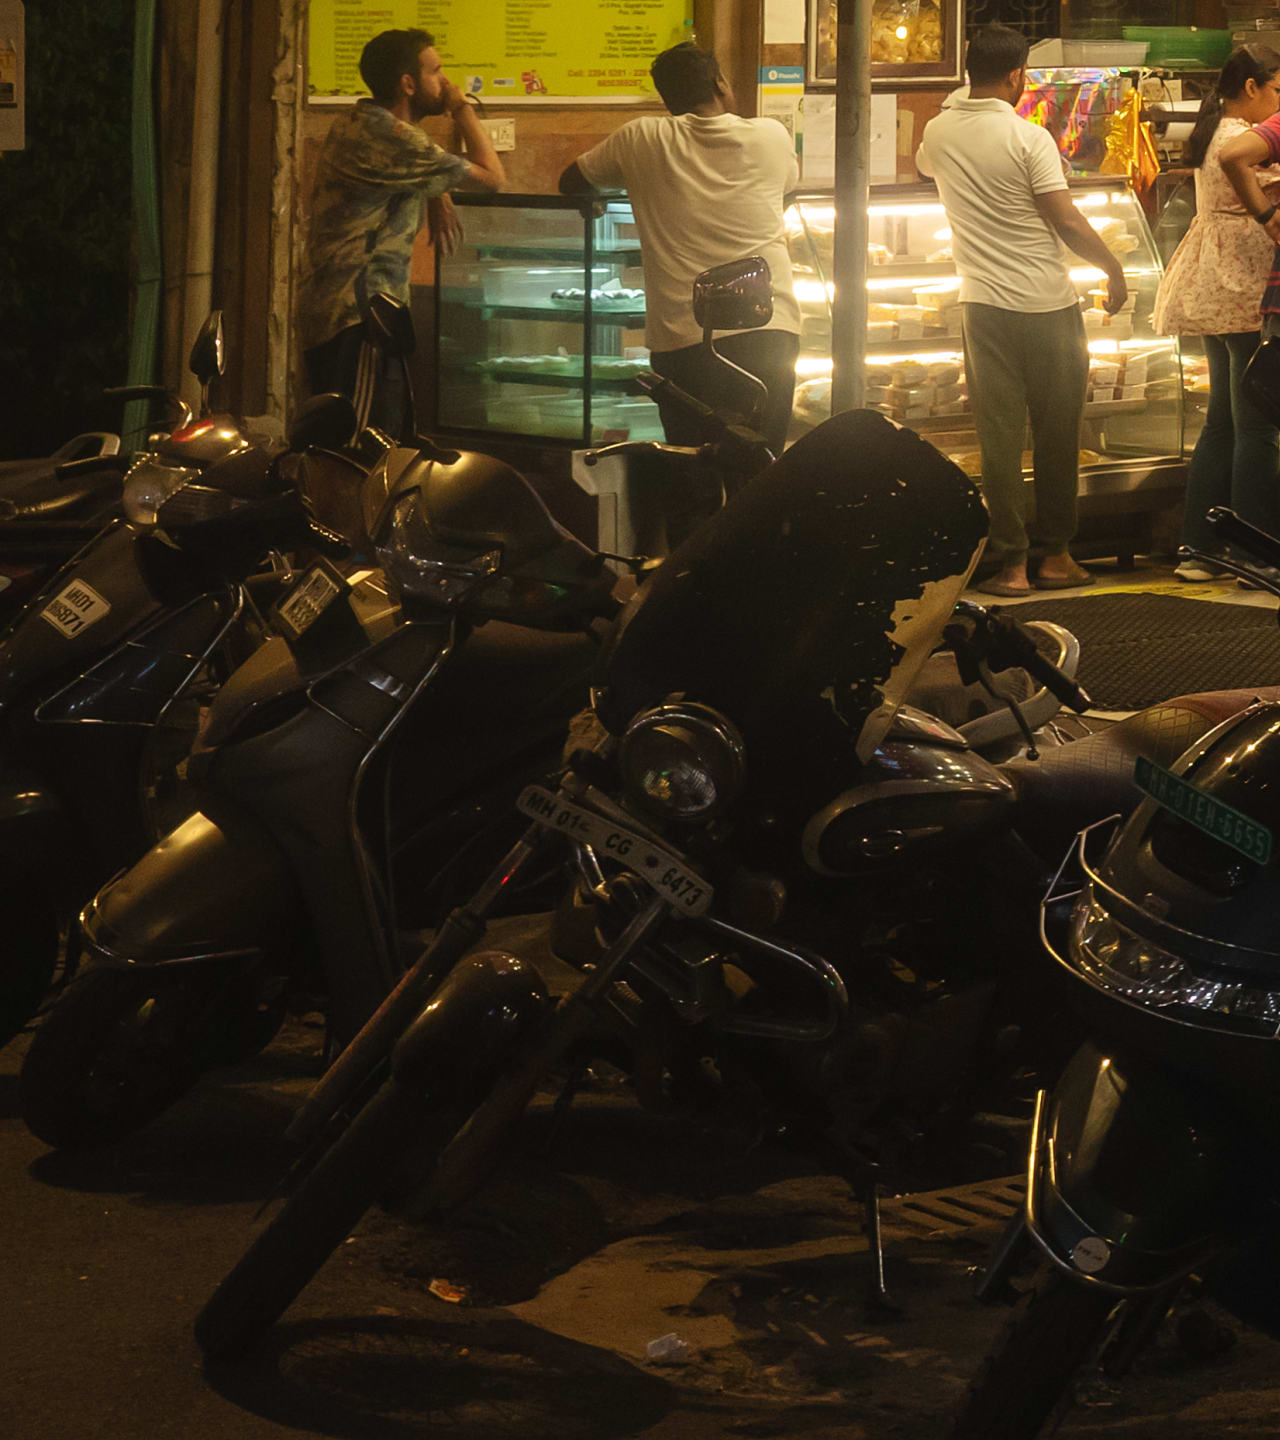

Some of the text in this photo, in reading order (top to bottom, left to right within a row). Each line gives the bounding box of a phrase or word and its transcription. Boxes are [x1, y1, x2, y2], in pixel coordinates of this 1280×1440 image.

[525, 792, 558, 819] MH
[605, 832, 634, 857] CG
[660, 867, 705, 907] 6473
